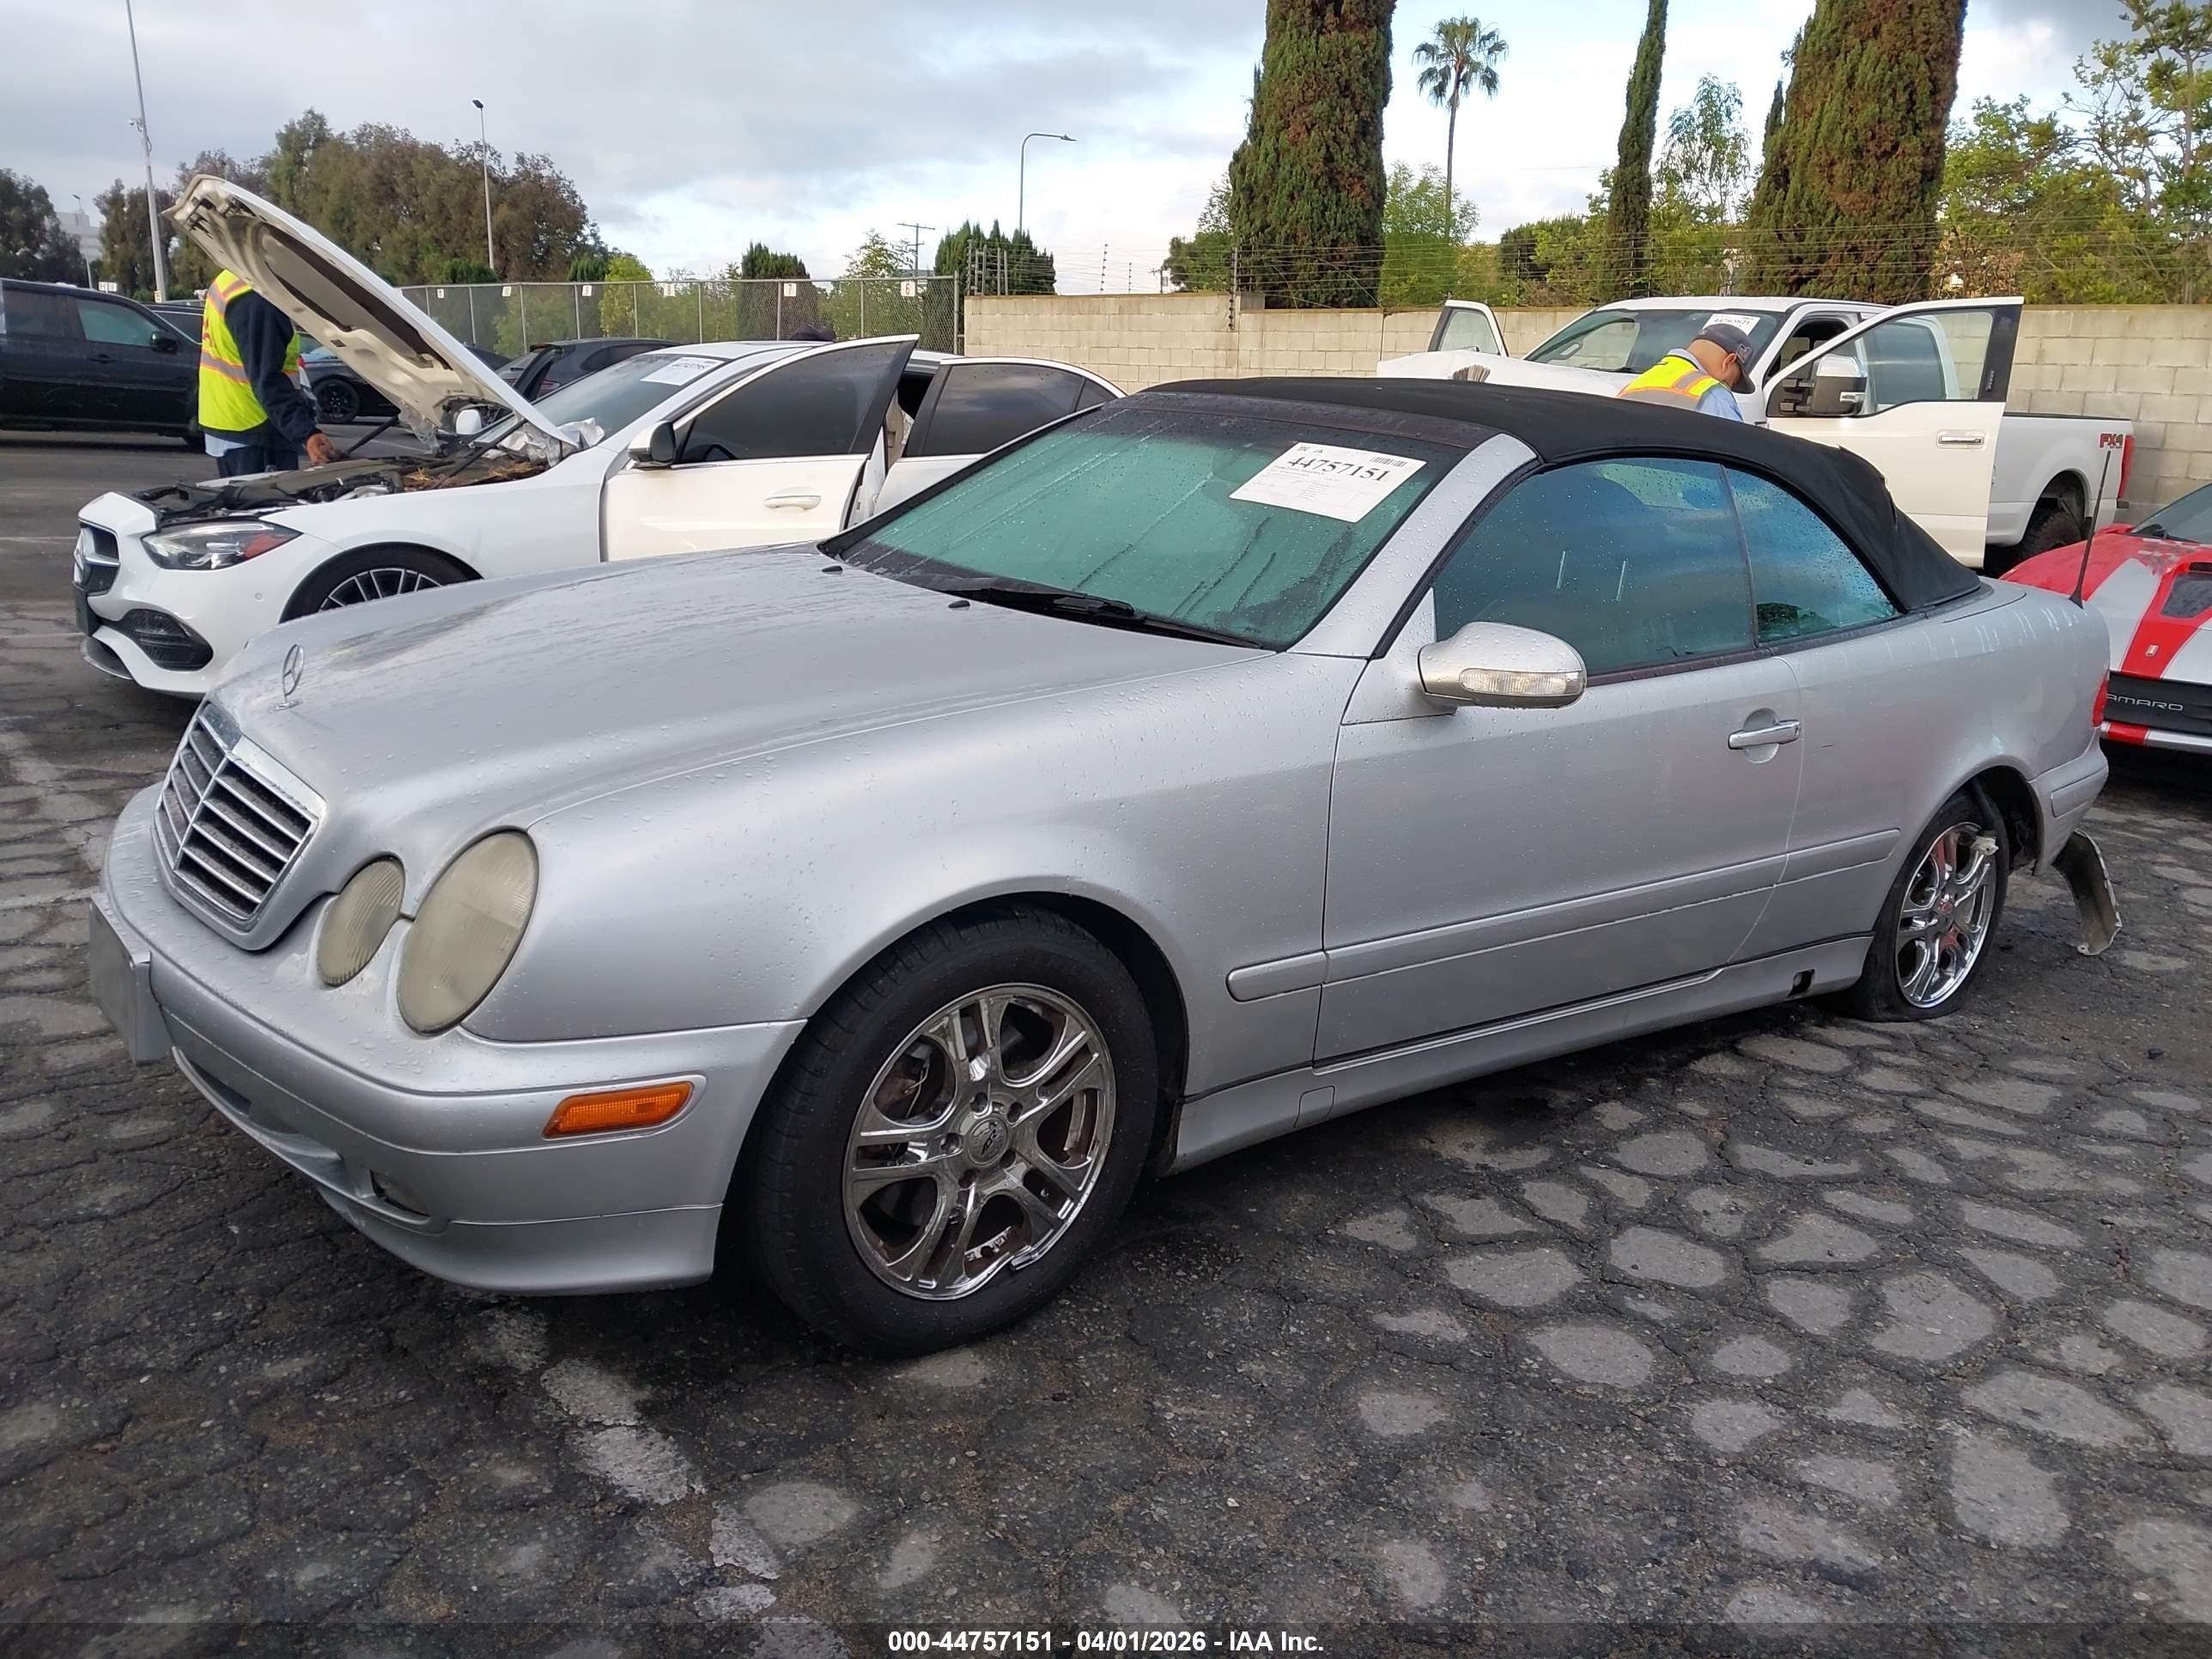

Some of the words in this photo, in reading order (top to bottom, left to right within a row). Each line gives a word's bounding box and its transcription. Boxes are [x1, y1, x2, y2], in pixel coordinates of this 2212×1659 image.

[2100, 433, 2124, 448] FX4
[1288, 456, 1391, 481] 44757151
[2106, 694, 2184, 711] AMARO
